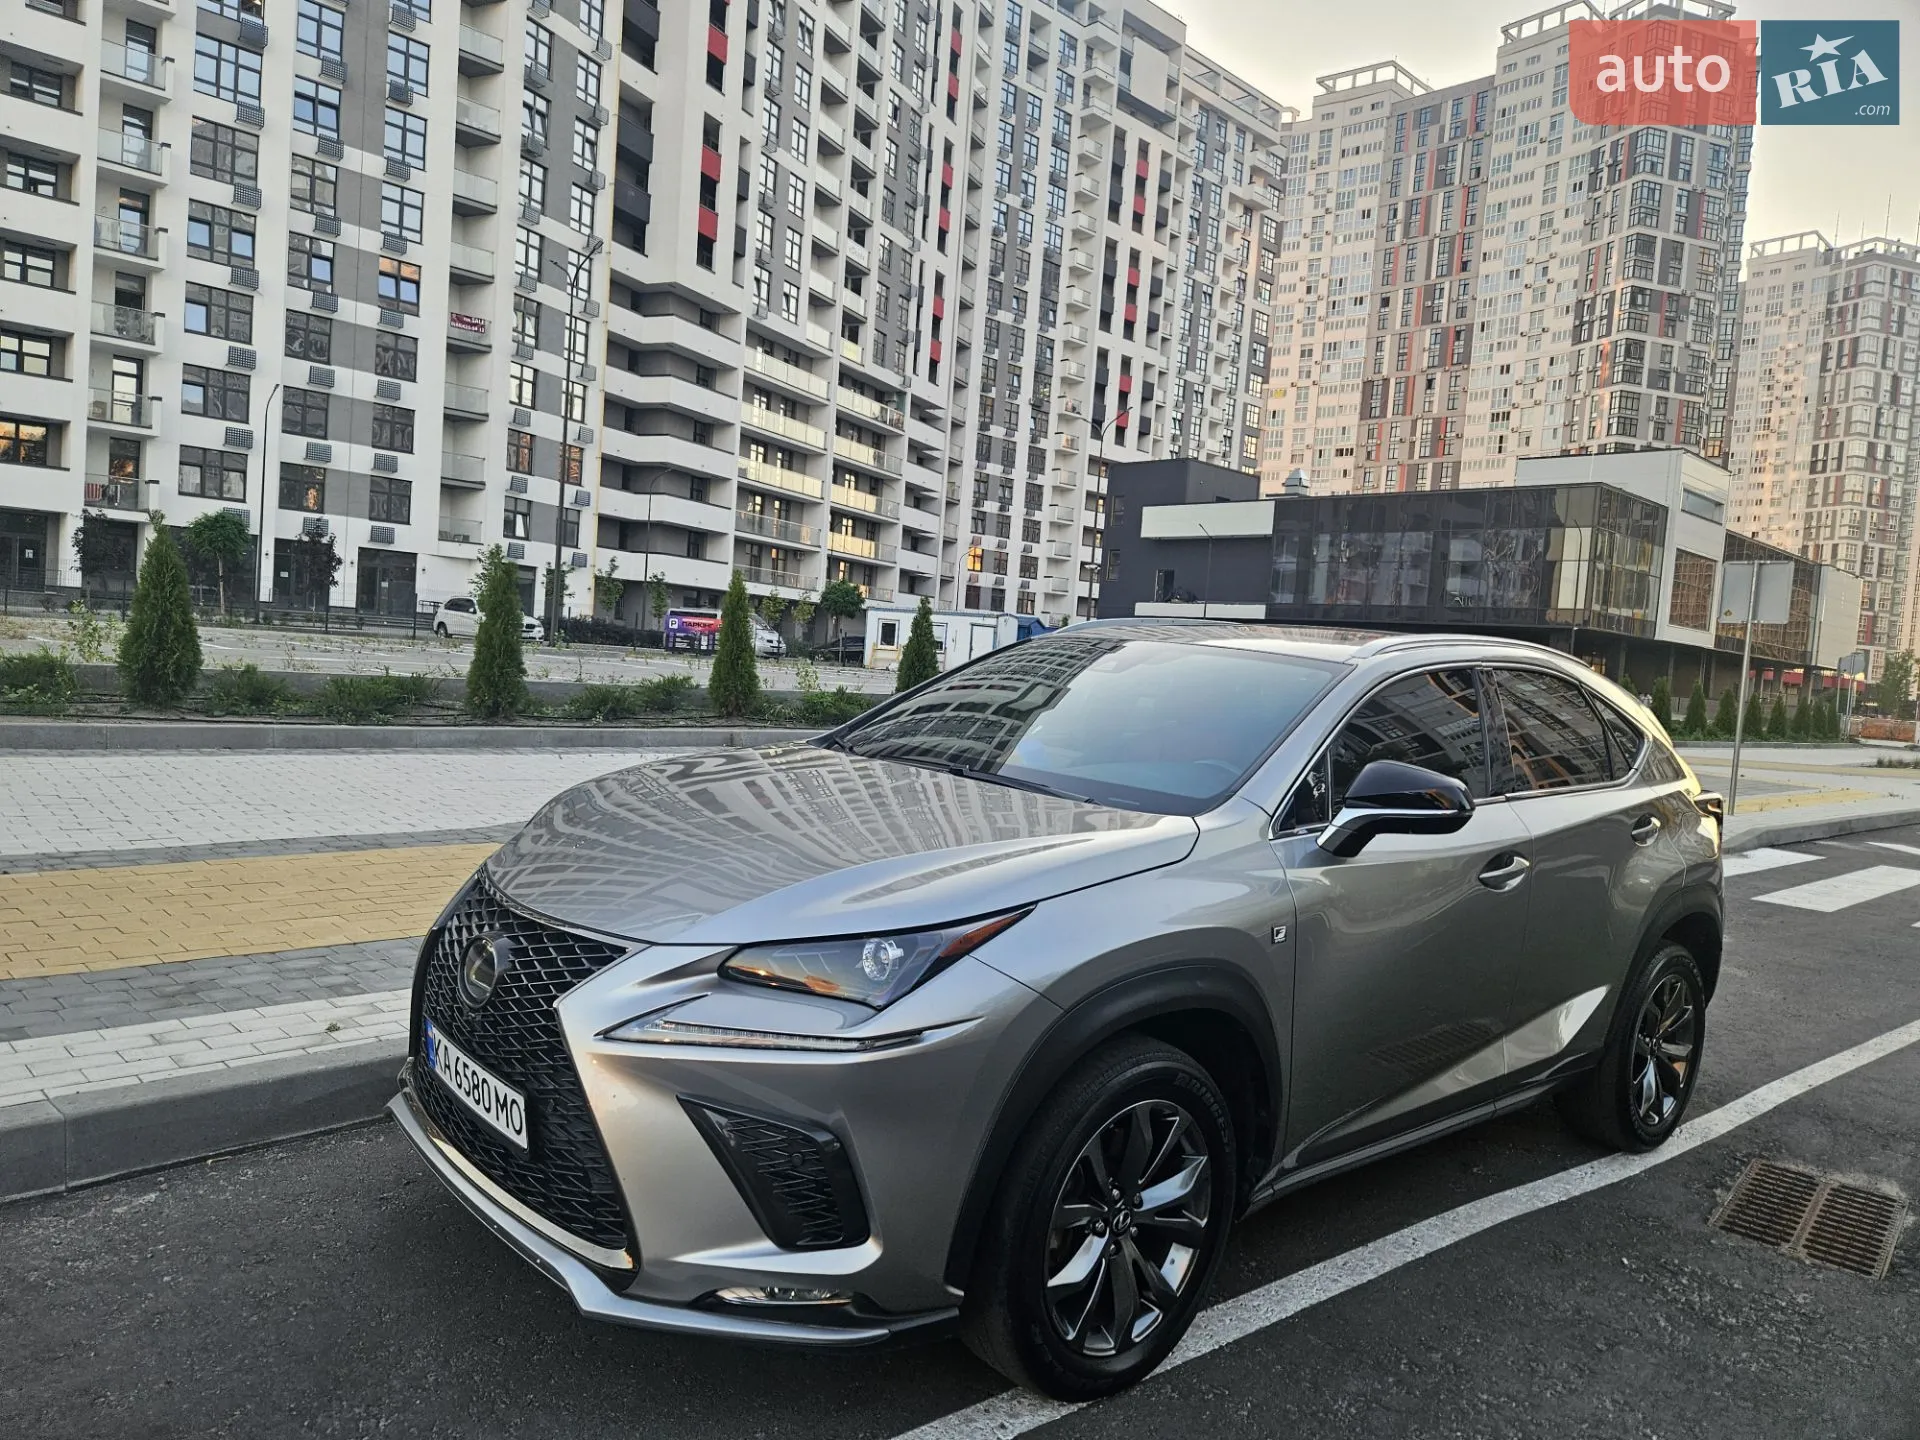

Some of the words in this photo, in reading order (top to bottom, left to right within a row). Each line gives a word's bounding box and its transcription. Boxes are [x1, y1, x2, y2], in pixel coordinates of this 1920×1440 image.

[433, 1032, 453, 1082] KA
[454, 1055, 492, 1115] 6580
[494, 1085, 523, 1136] MO
